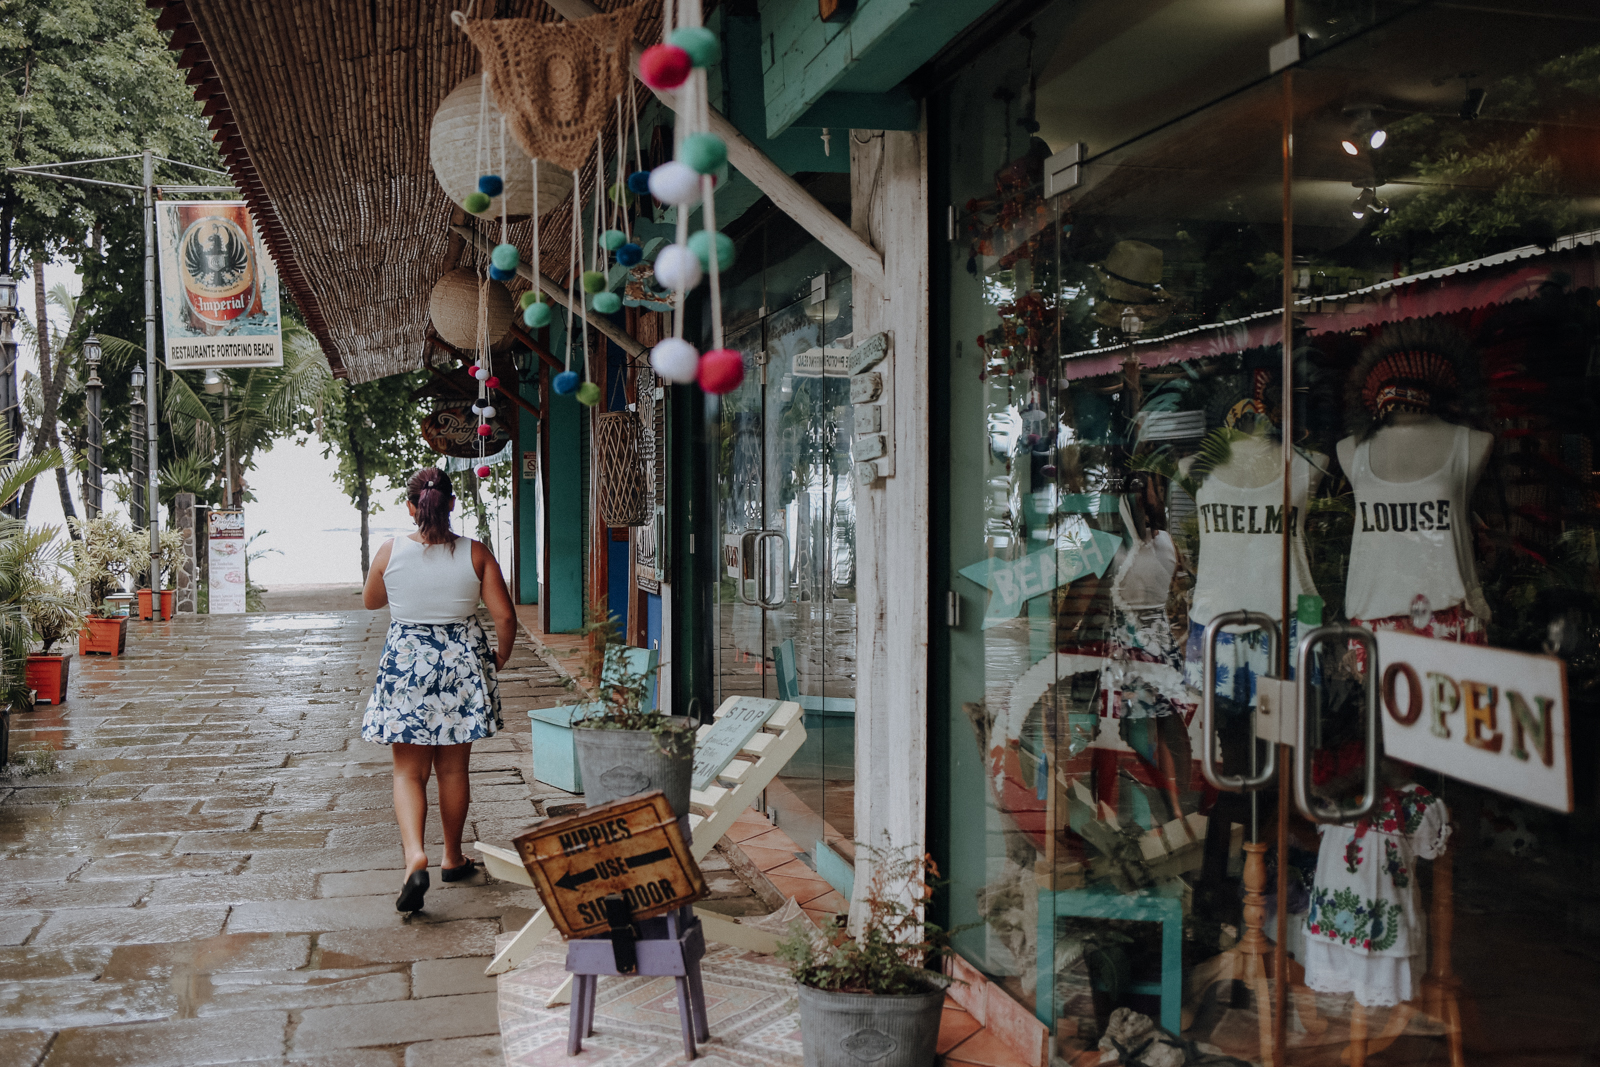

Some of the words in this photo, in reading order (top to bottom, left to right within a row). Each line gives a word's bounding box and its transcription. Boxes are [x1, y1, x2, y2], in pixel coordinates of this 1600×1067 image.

[198, 294, 245, 317] Imperial
[171, 345, 216, 360] RESTAURANTE
[216, 343, 252, 358] PORTOFINO
[253, 342, 275, 357] BEACH
[1359, 499, 1451, 533] LOUISE
[725, 706, 765, 723] STOP
[1382, 661, 1555, 769] OPEN
[558, 818, 632, 857] HIPPIES
[594, 856, 629, 880] USE
[577, 893, 617, 925] SID
[621, 878, 677, 911] DOOR
